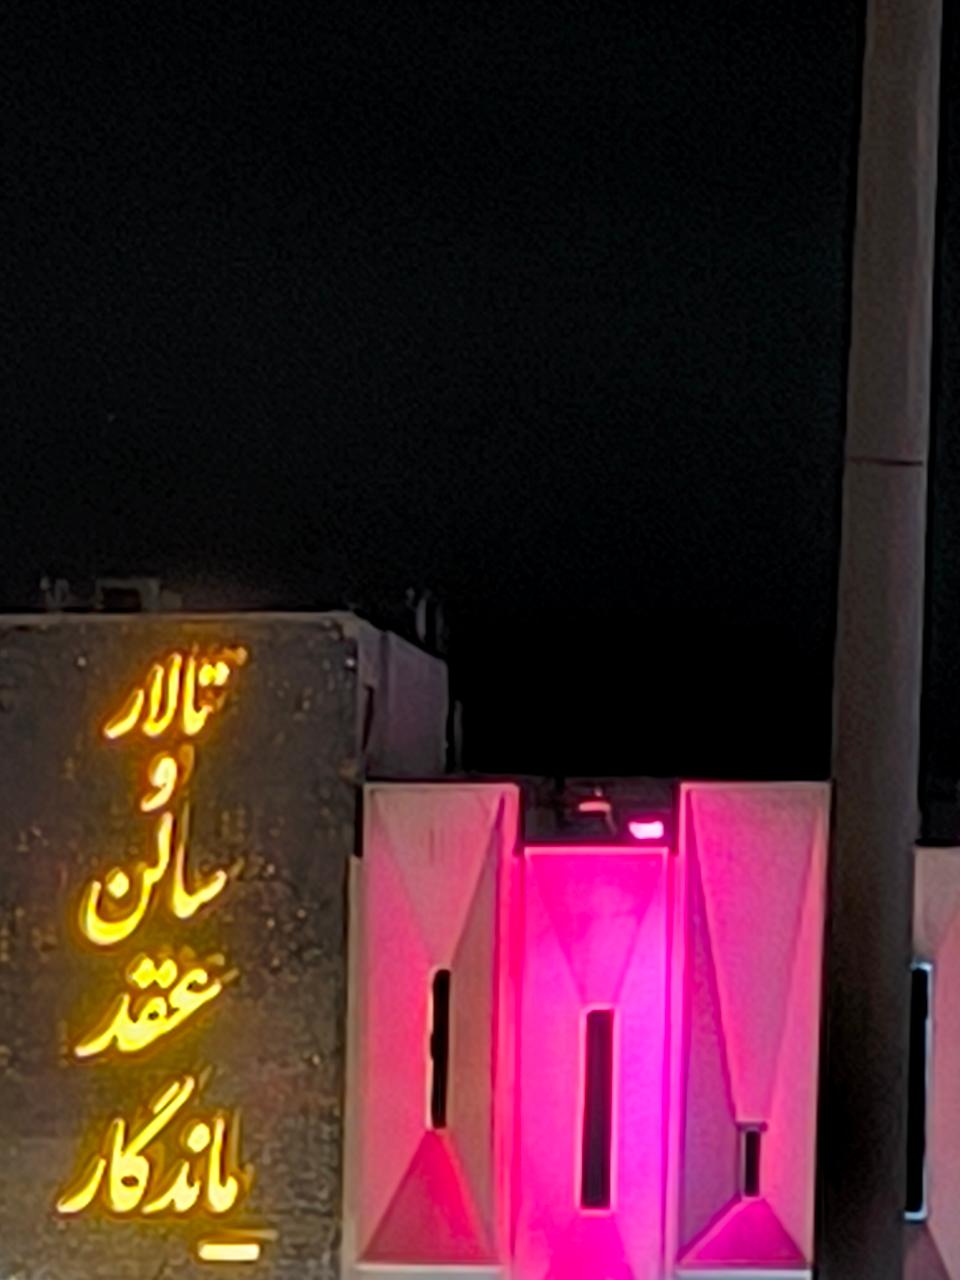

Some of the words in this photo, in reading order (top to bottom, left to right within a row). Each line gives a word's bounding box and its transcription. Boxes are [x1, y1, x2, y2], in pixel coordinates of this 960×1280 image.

[103, 651, 232, 739] تالار
[139, 756, 178, 812] و
[83, 811, 228, 945] سالن
[73, 956, 224, 1058] عقد
[56, 1076, 239, 1214] ماندگار
